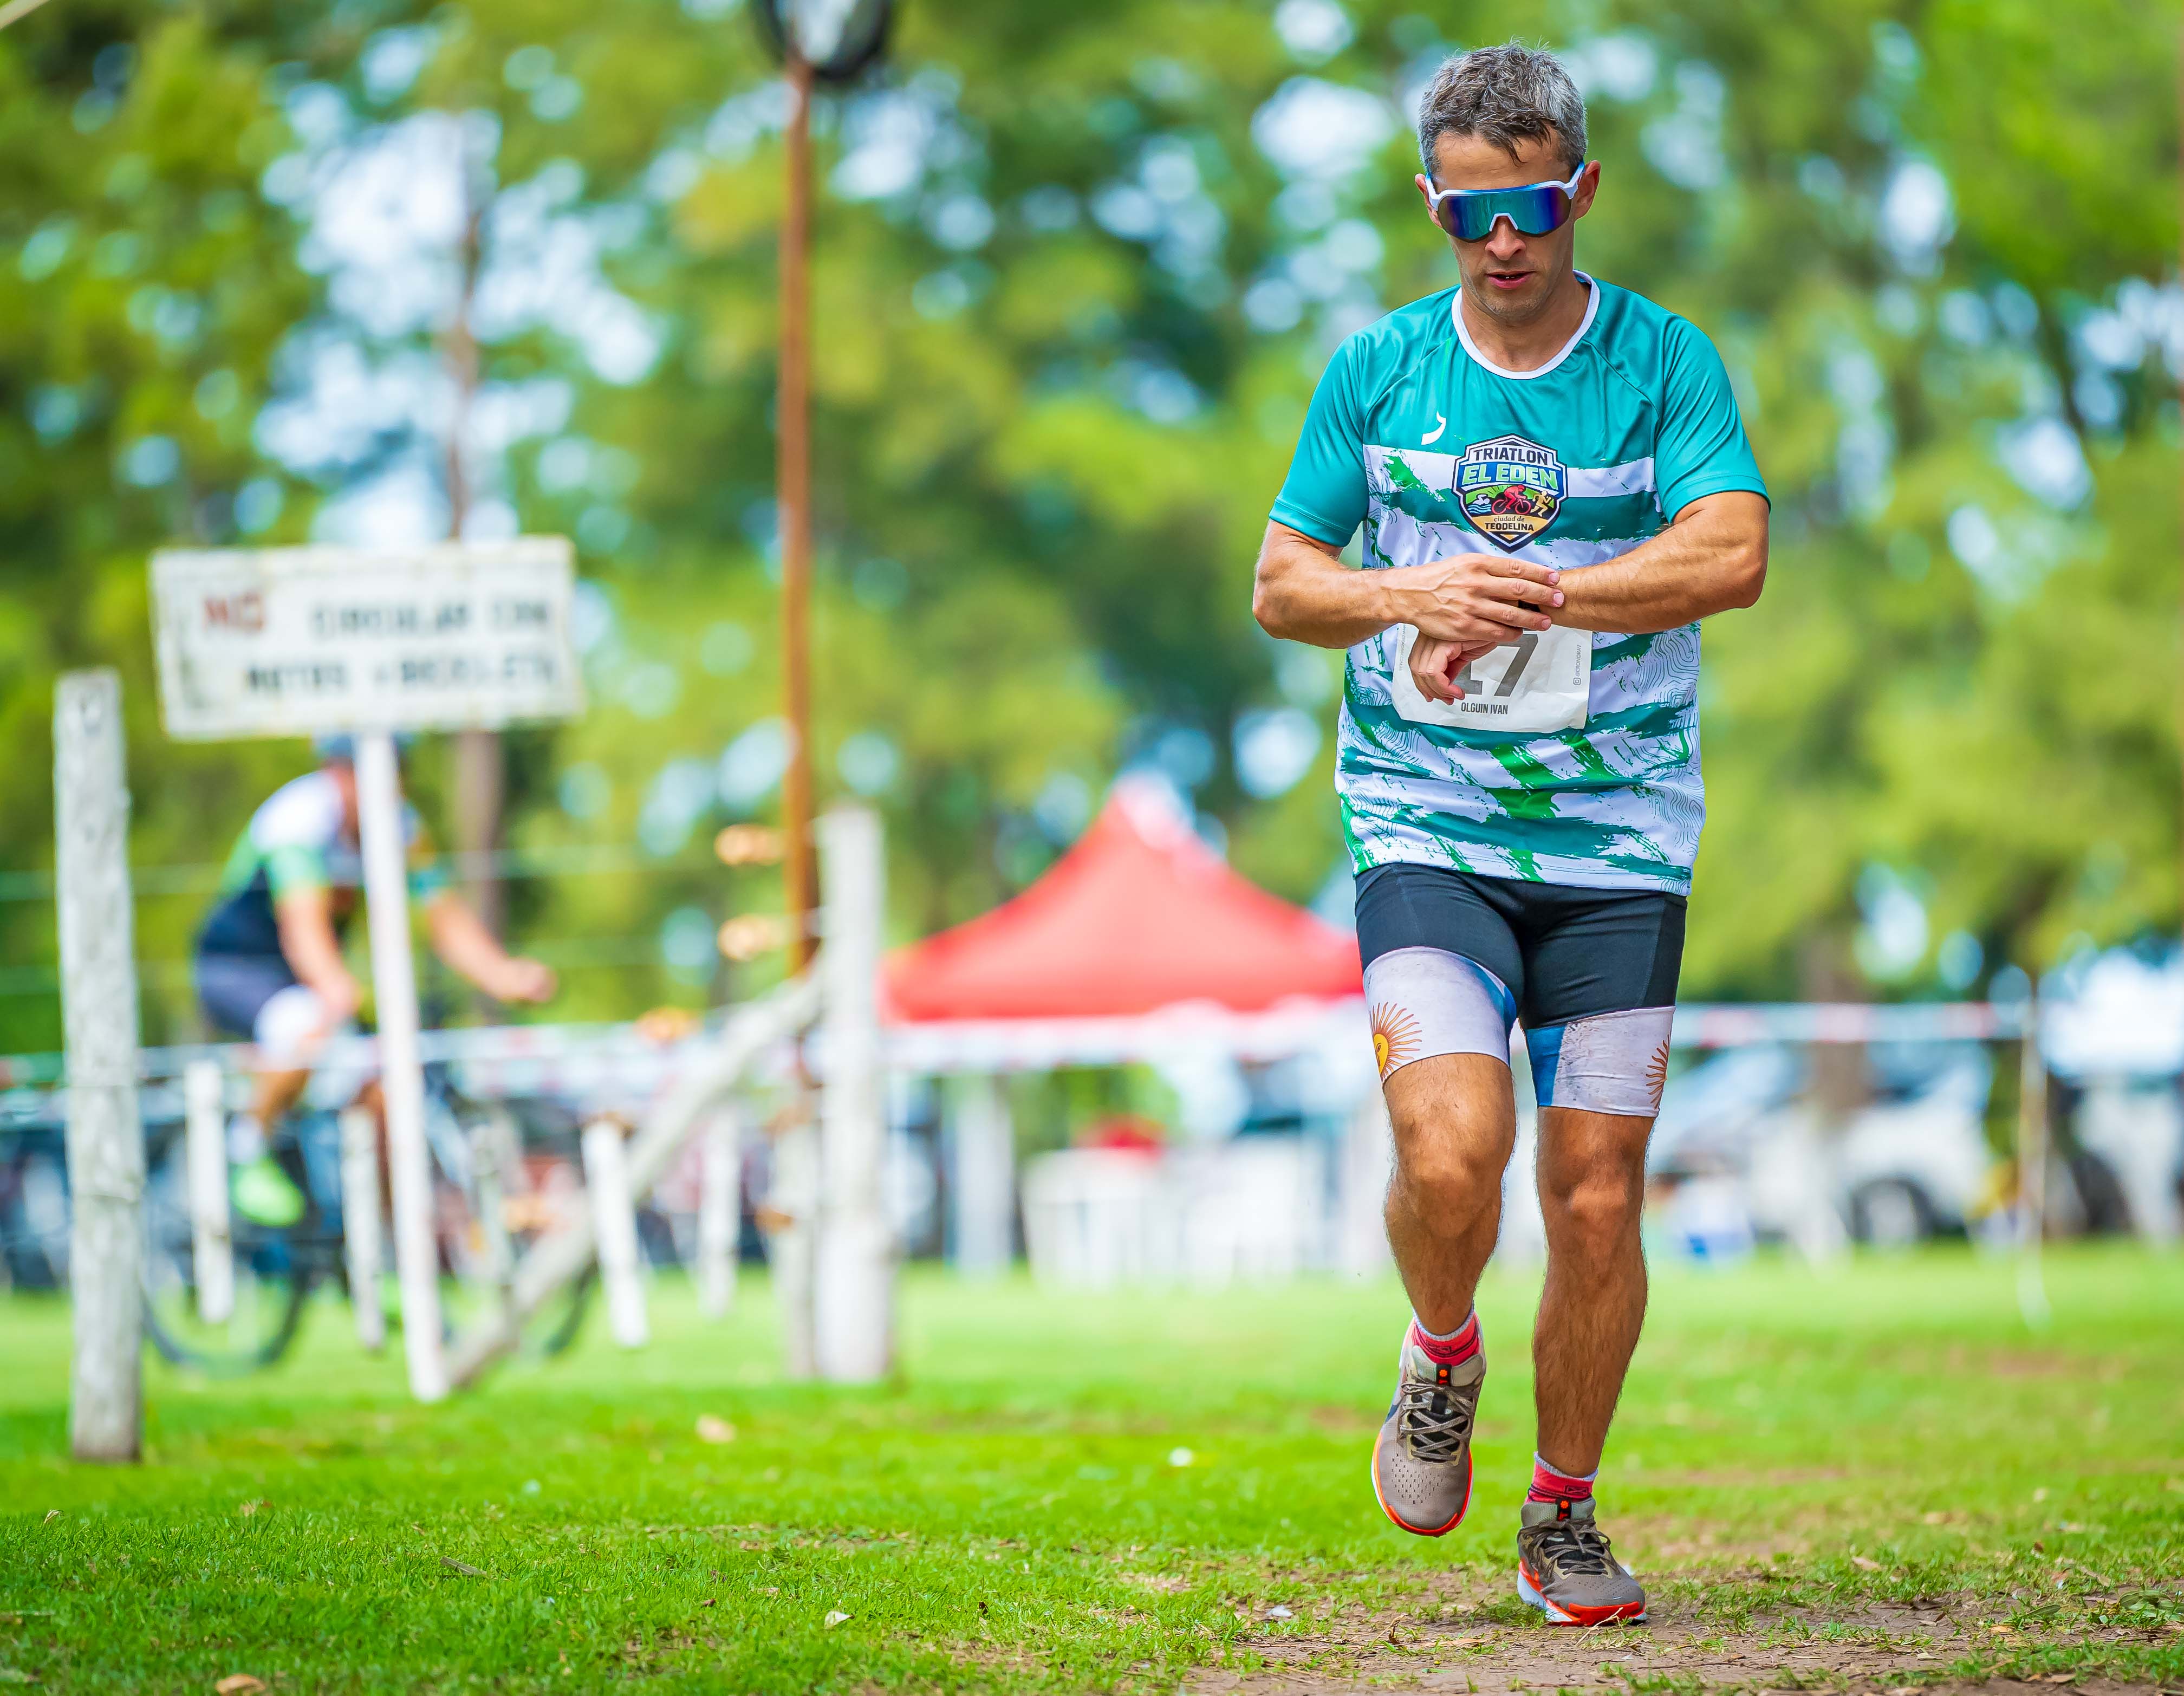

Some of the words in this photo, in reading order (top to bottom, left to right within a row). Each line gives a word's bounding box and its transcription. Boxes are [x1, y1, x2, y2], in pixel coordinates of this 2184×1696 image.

[1473, 447, 1548, 466] TRIATLON
[1462, 464, 1492, 486] EL
[1496, 463, 1558, 490] EDEN
[1485, 522, 1535, 531] TEODELINA
[1461, 702, 1488, 713] OLGUIN
[1490, 704, 1509, 714] IVAN
